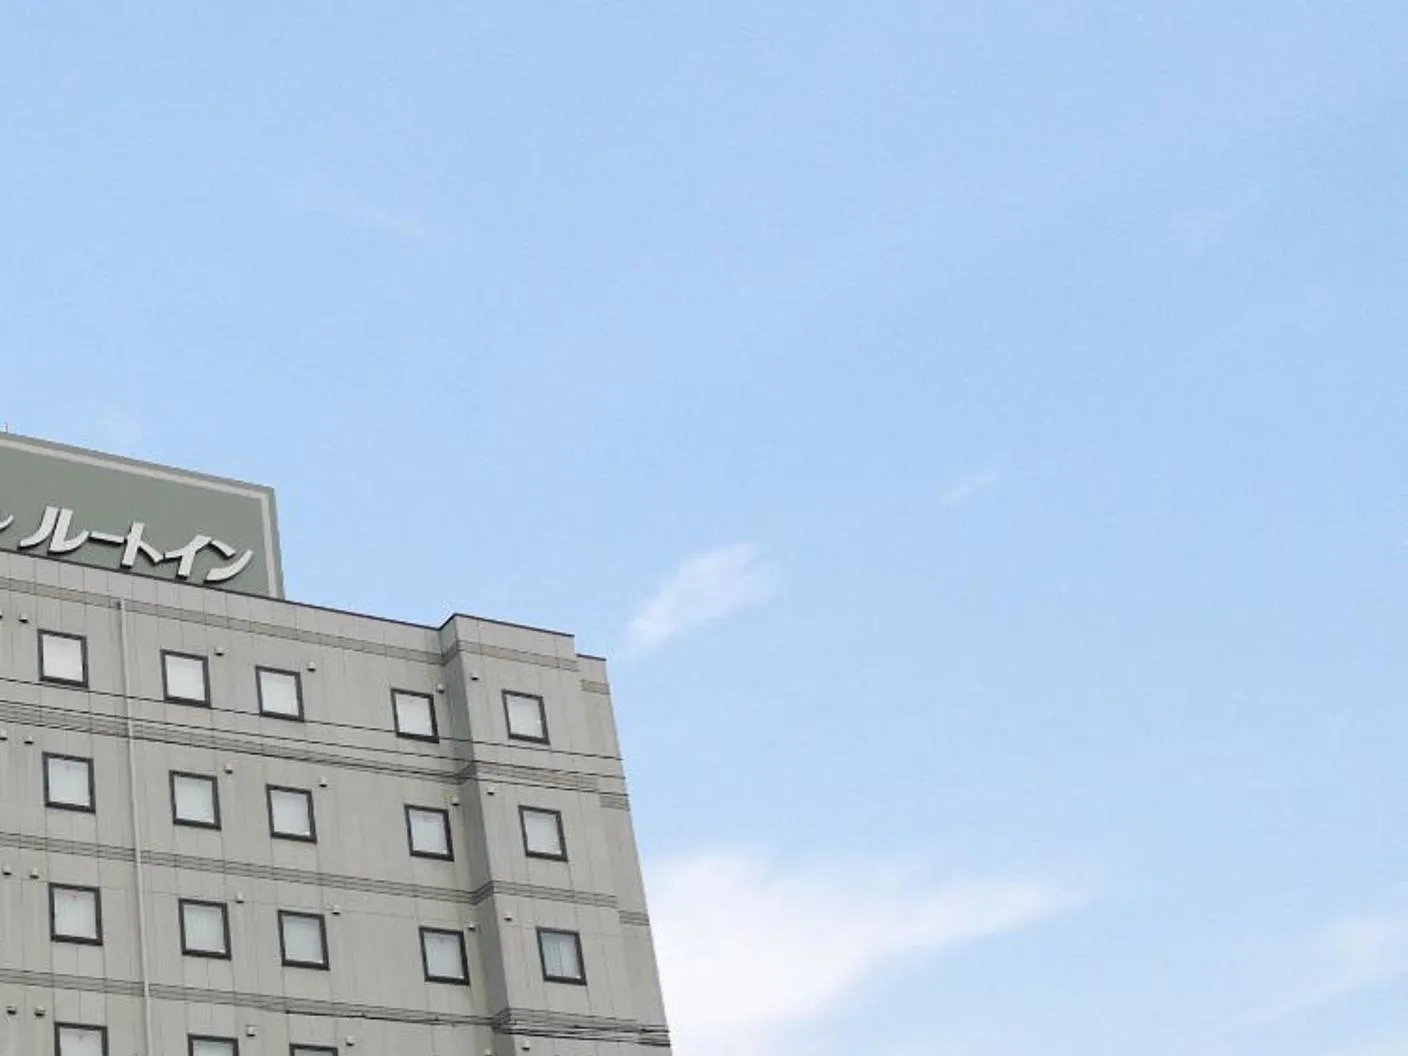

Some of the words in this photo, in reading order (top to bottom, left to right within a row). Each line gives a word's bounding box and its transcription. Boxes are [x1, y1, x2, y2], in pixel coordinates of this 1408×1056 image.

[19, 506, 253, 583] ルートイン
